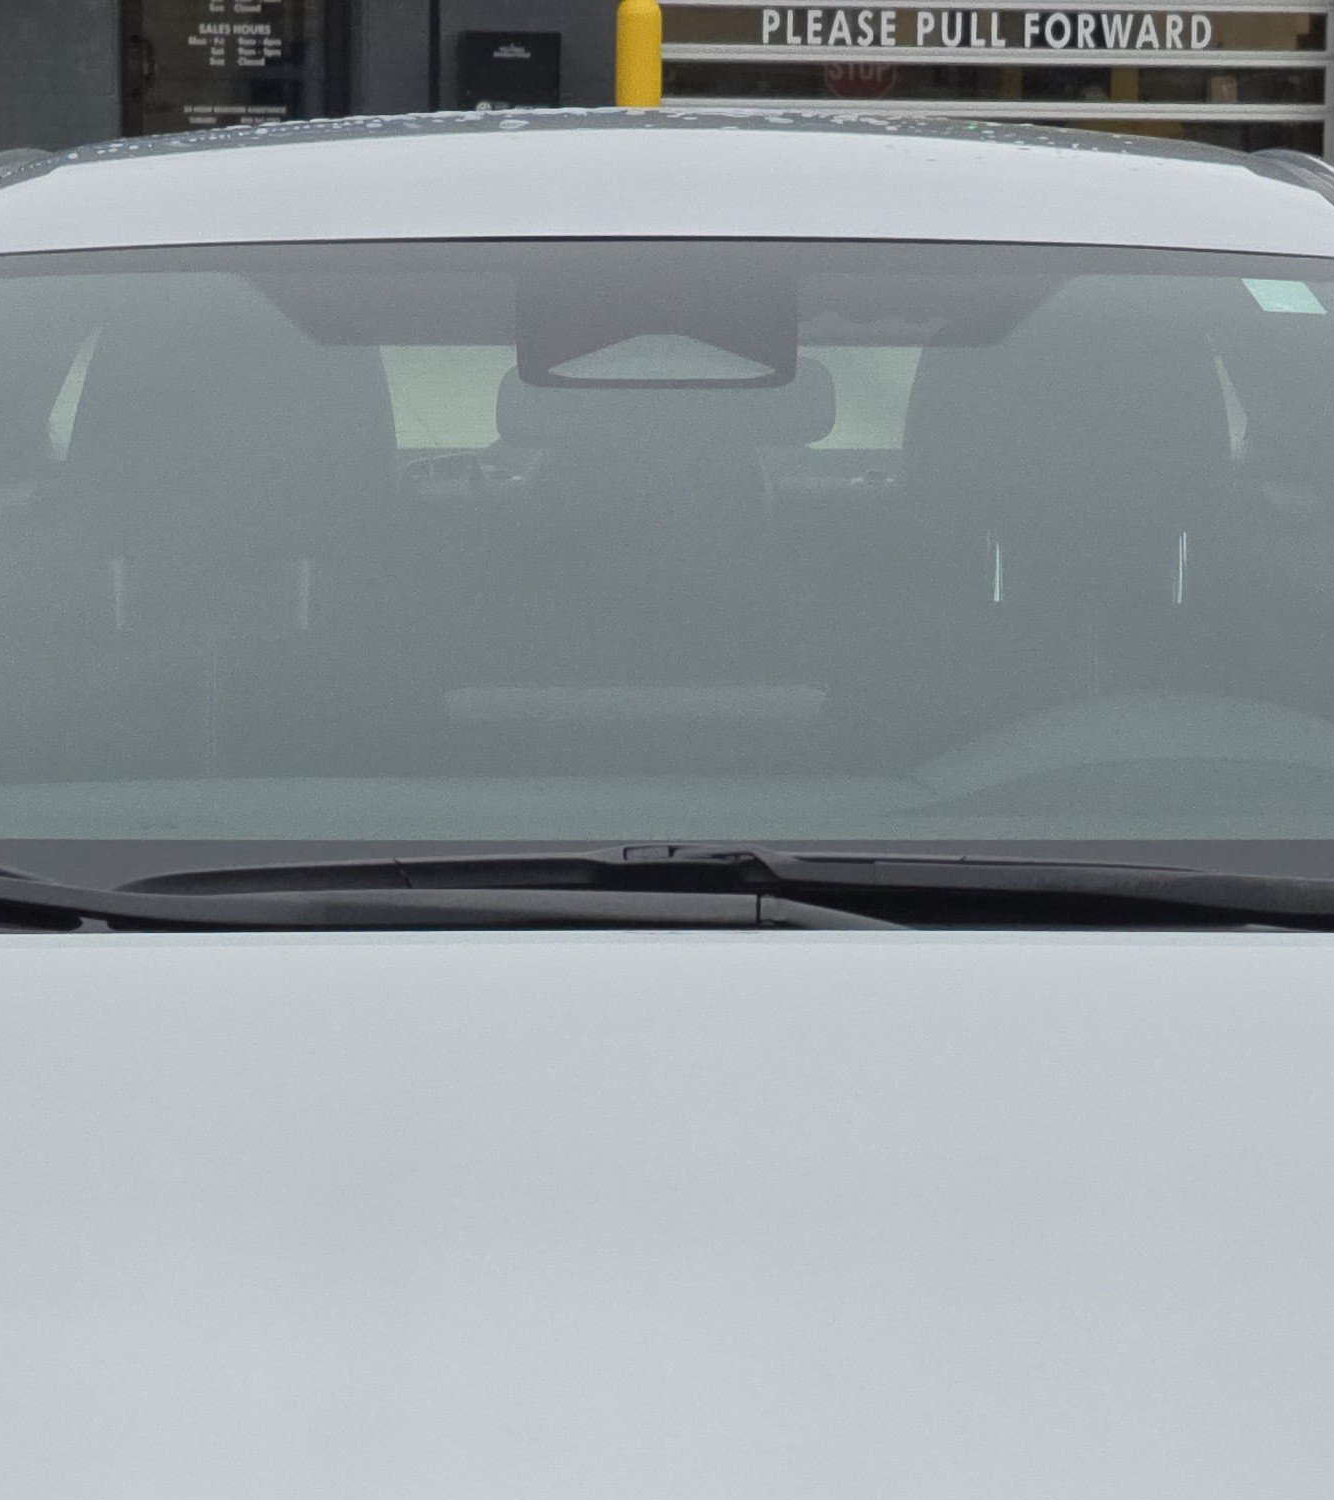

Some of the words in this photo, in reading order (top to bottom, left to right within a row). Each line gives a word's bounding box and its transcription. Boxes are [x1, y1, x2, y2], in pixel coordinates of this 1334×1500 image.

[233, 24, 271, 35] HOURS
[762, 9, 896, 47] PLEASE
[917, 11, 1006, 48] PULL
[1024, 13, 1212, 49] FORWARD
